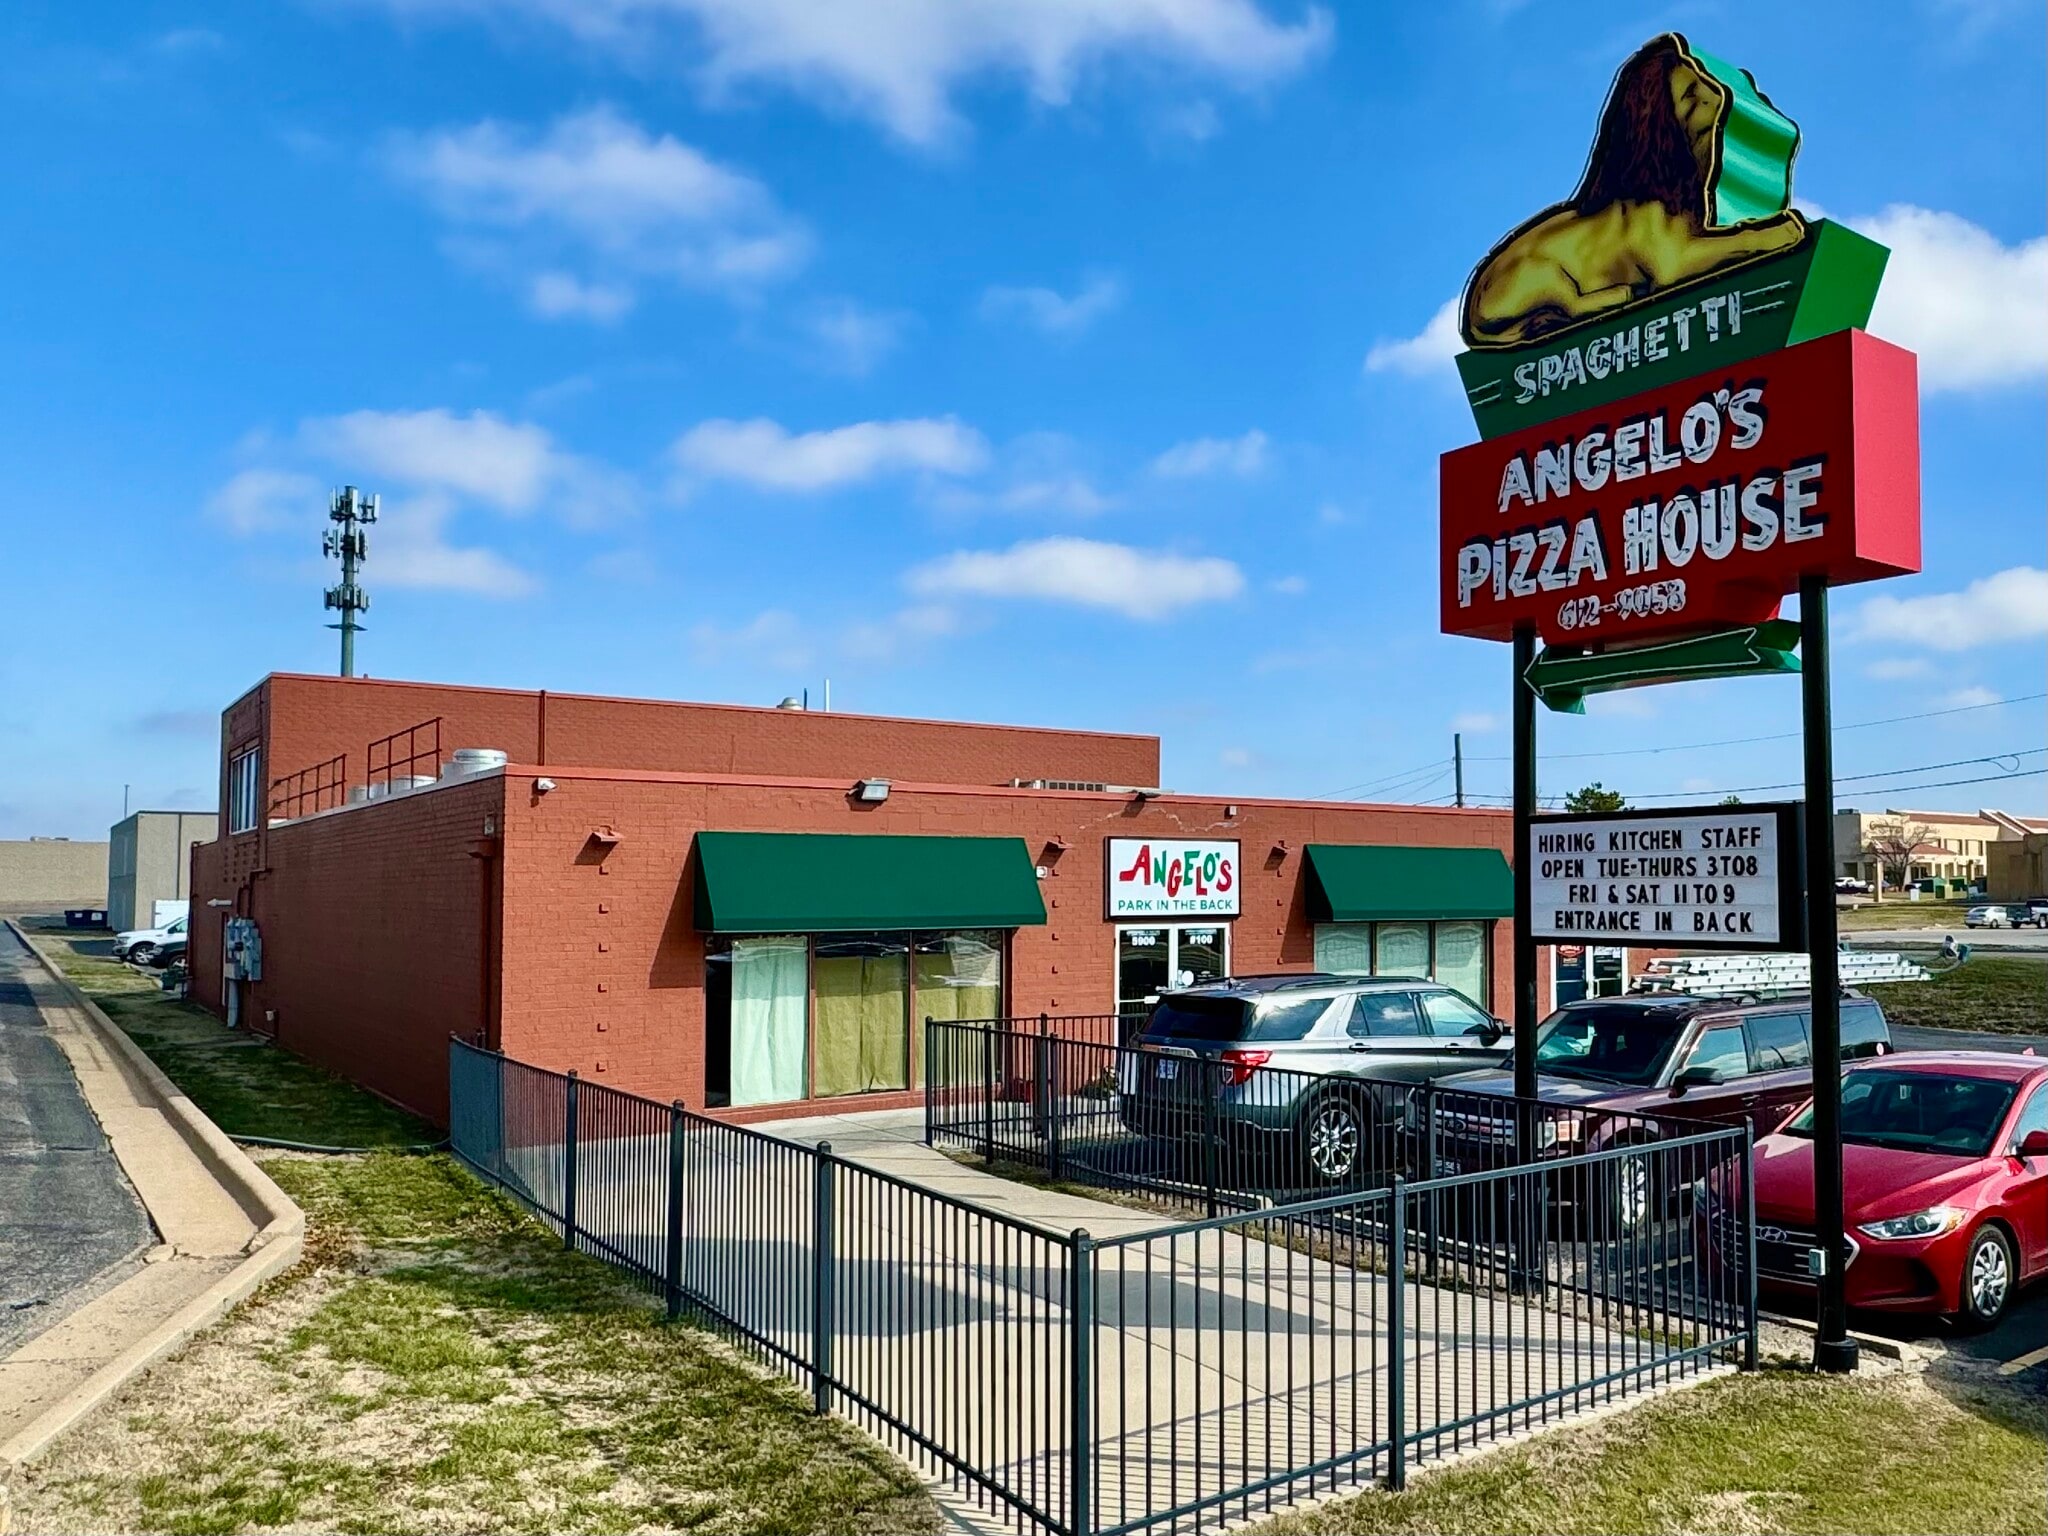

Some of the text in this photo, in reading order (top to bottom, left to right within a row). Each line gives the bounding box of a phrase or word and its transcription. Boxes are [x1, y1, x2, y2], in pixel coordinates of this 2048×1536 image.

[1513, 290, 1741, 405] SPAGHETTI
[1498, 387, 1765, 513] ANGELO'S
[1457, 462, 1824, 608] PIZZA HOUSE
[1538, 826, 1762, 853] HIRING KITCHEN STAFF
[1119, 844, 1233, 898] ANGELO'S
[1541, 859, 1585, 878] OPEN
[1597, 856, 1697, 878] TUE-THURS
[1118, 899, 1233, 911] PARK IN THE BACK
[1569, 884, 1598, 904] FRI
[1608, 885, 1620, 903] &
[1626, 884, 1661, 904] SAT
[1555, 910, 1752, 933] ENTRANCE IN BACK
